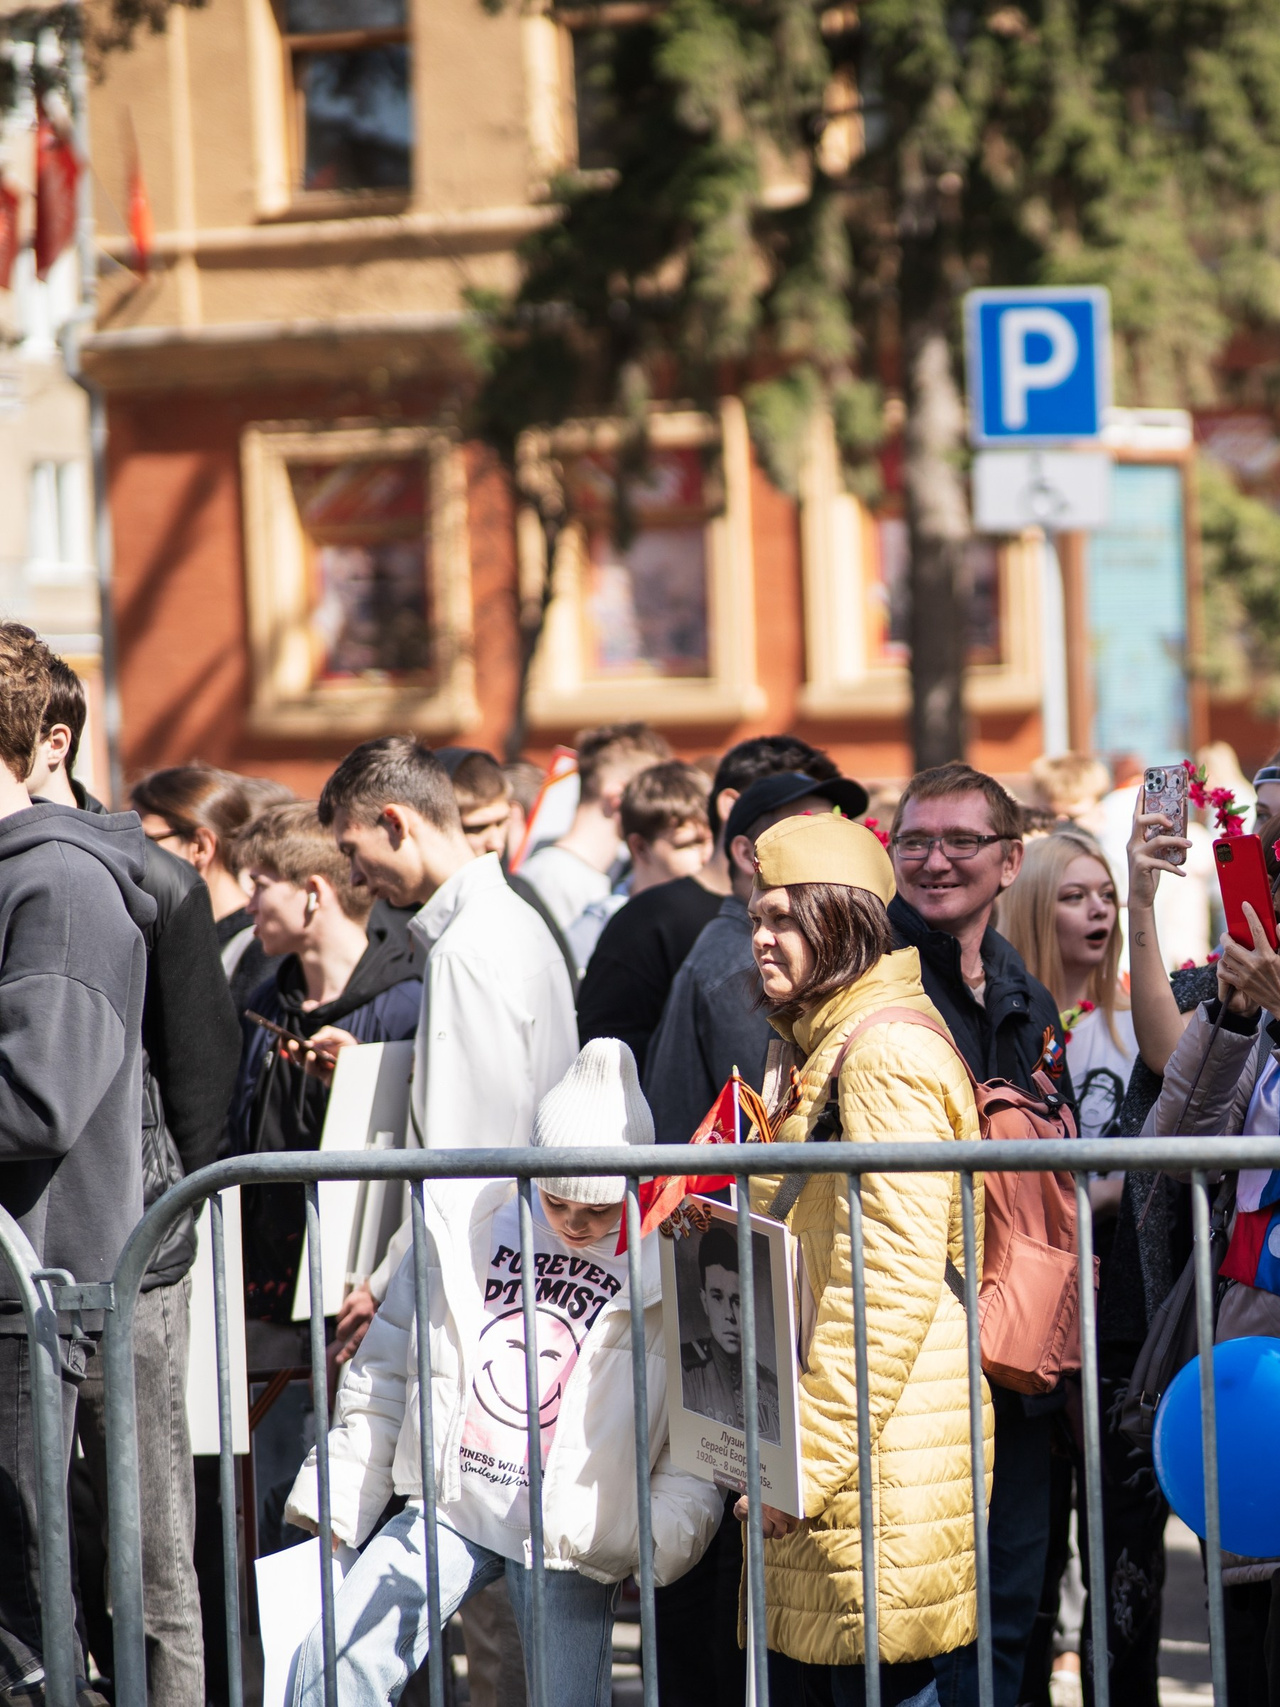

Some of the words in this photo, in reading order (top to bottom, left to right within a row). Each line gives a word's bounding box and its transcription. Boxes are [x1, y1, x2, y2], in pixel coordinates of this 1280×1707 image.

[997, 307, 1079, 431] P
[491, 1244, 622, 1298] FOREVER
[485, 1277, 610, 1331] PTMIST
[701, 1437, 728, 1457] Сергей
[730, 1449, 766, 1473] Егорч
[720, 1431, 745, 1449] Лузин
[498, 1460, 525, 1476] WILL
[696, 1450, 718, 1467] 1920г.
[723, 1461, 729, 1471] 8
